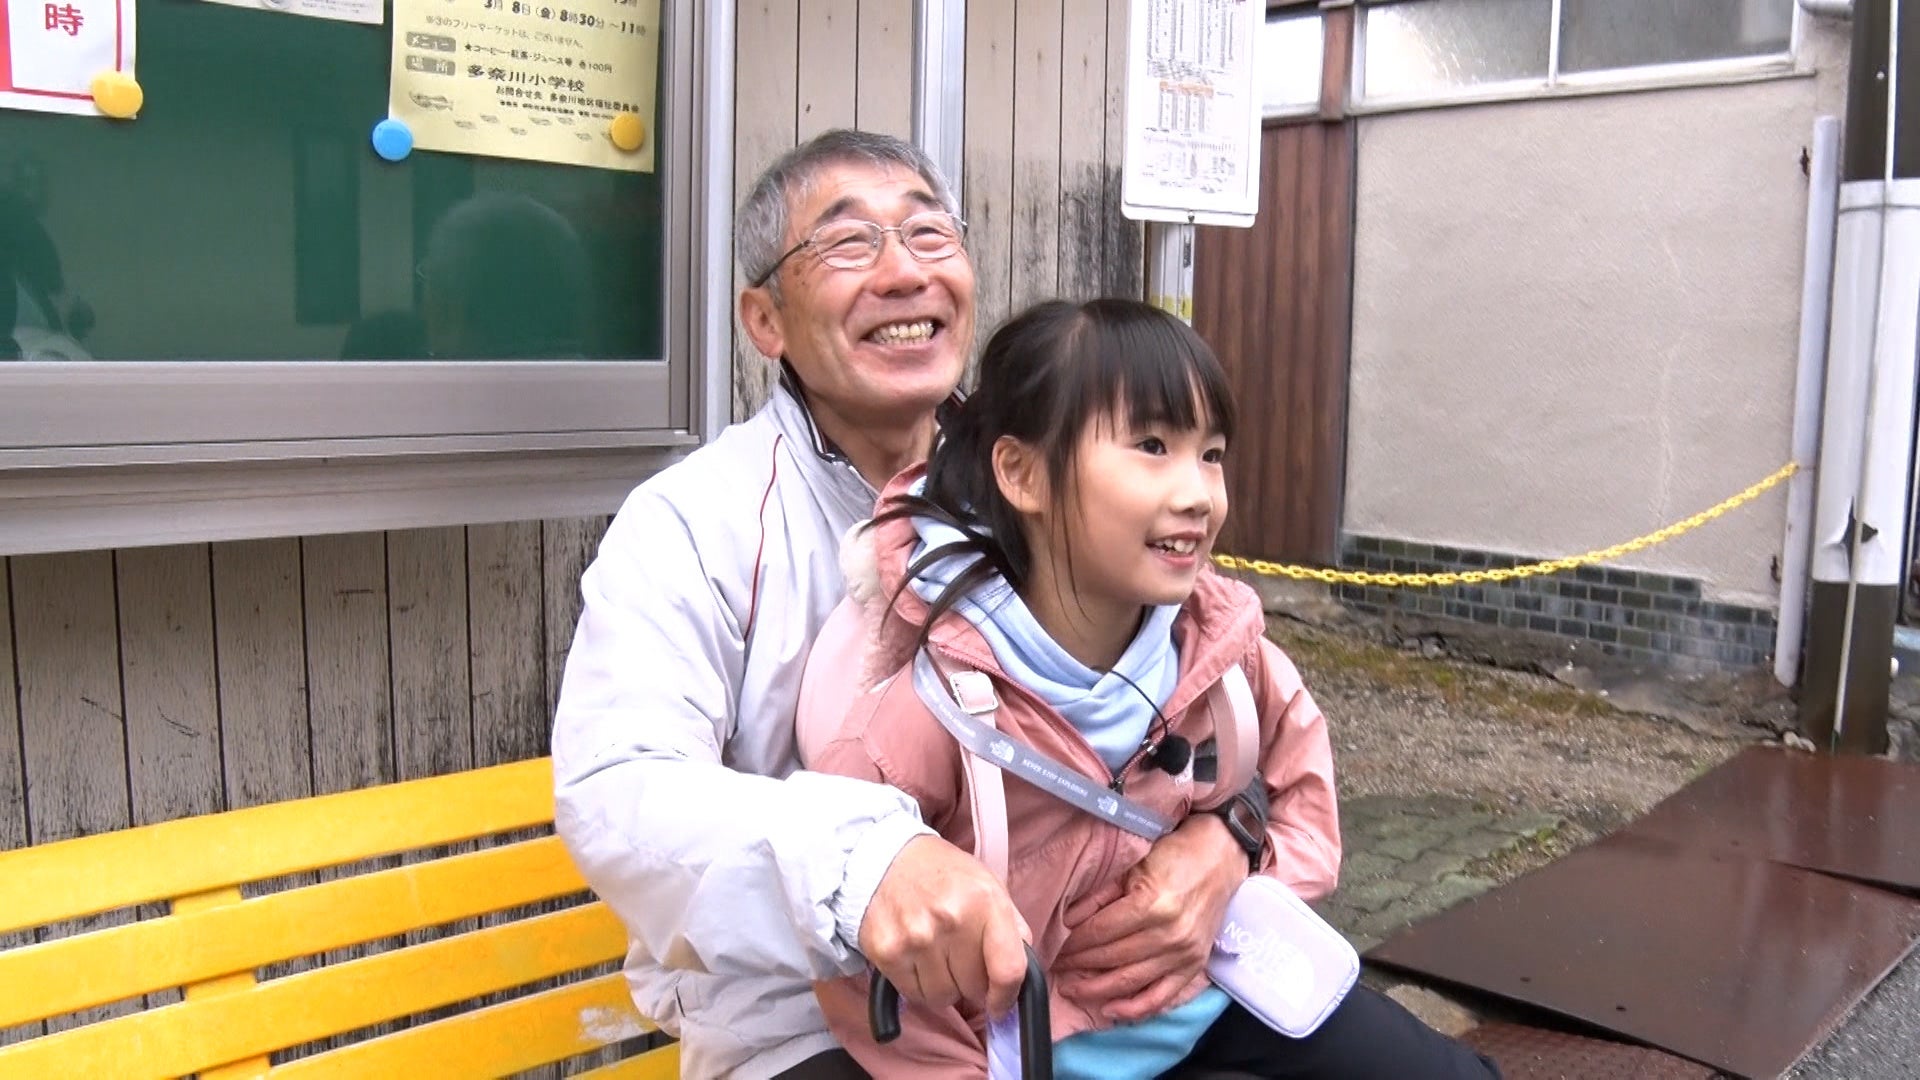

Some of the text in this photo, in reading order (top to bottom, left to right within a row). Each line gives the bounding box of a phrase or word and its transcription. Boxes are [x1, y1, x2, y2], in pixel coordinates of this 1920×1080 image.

[45, 3, 84, 36] 時
[467, 63, 585, 92] 多奈川小学校
